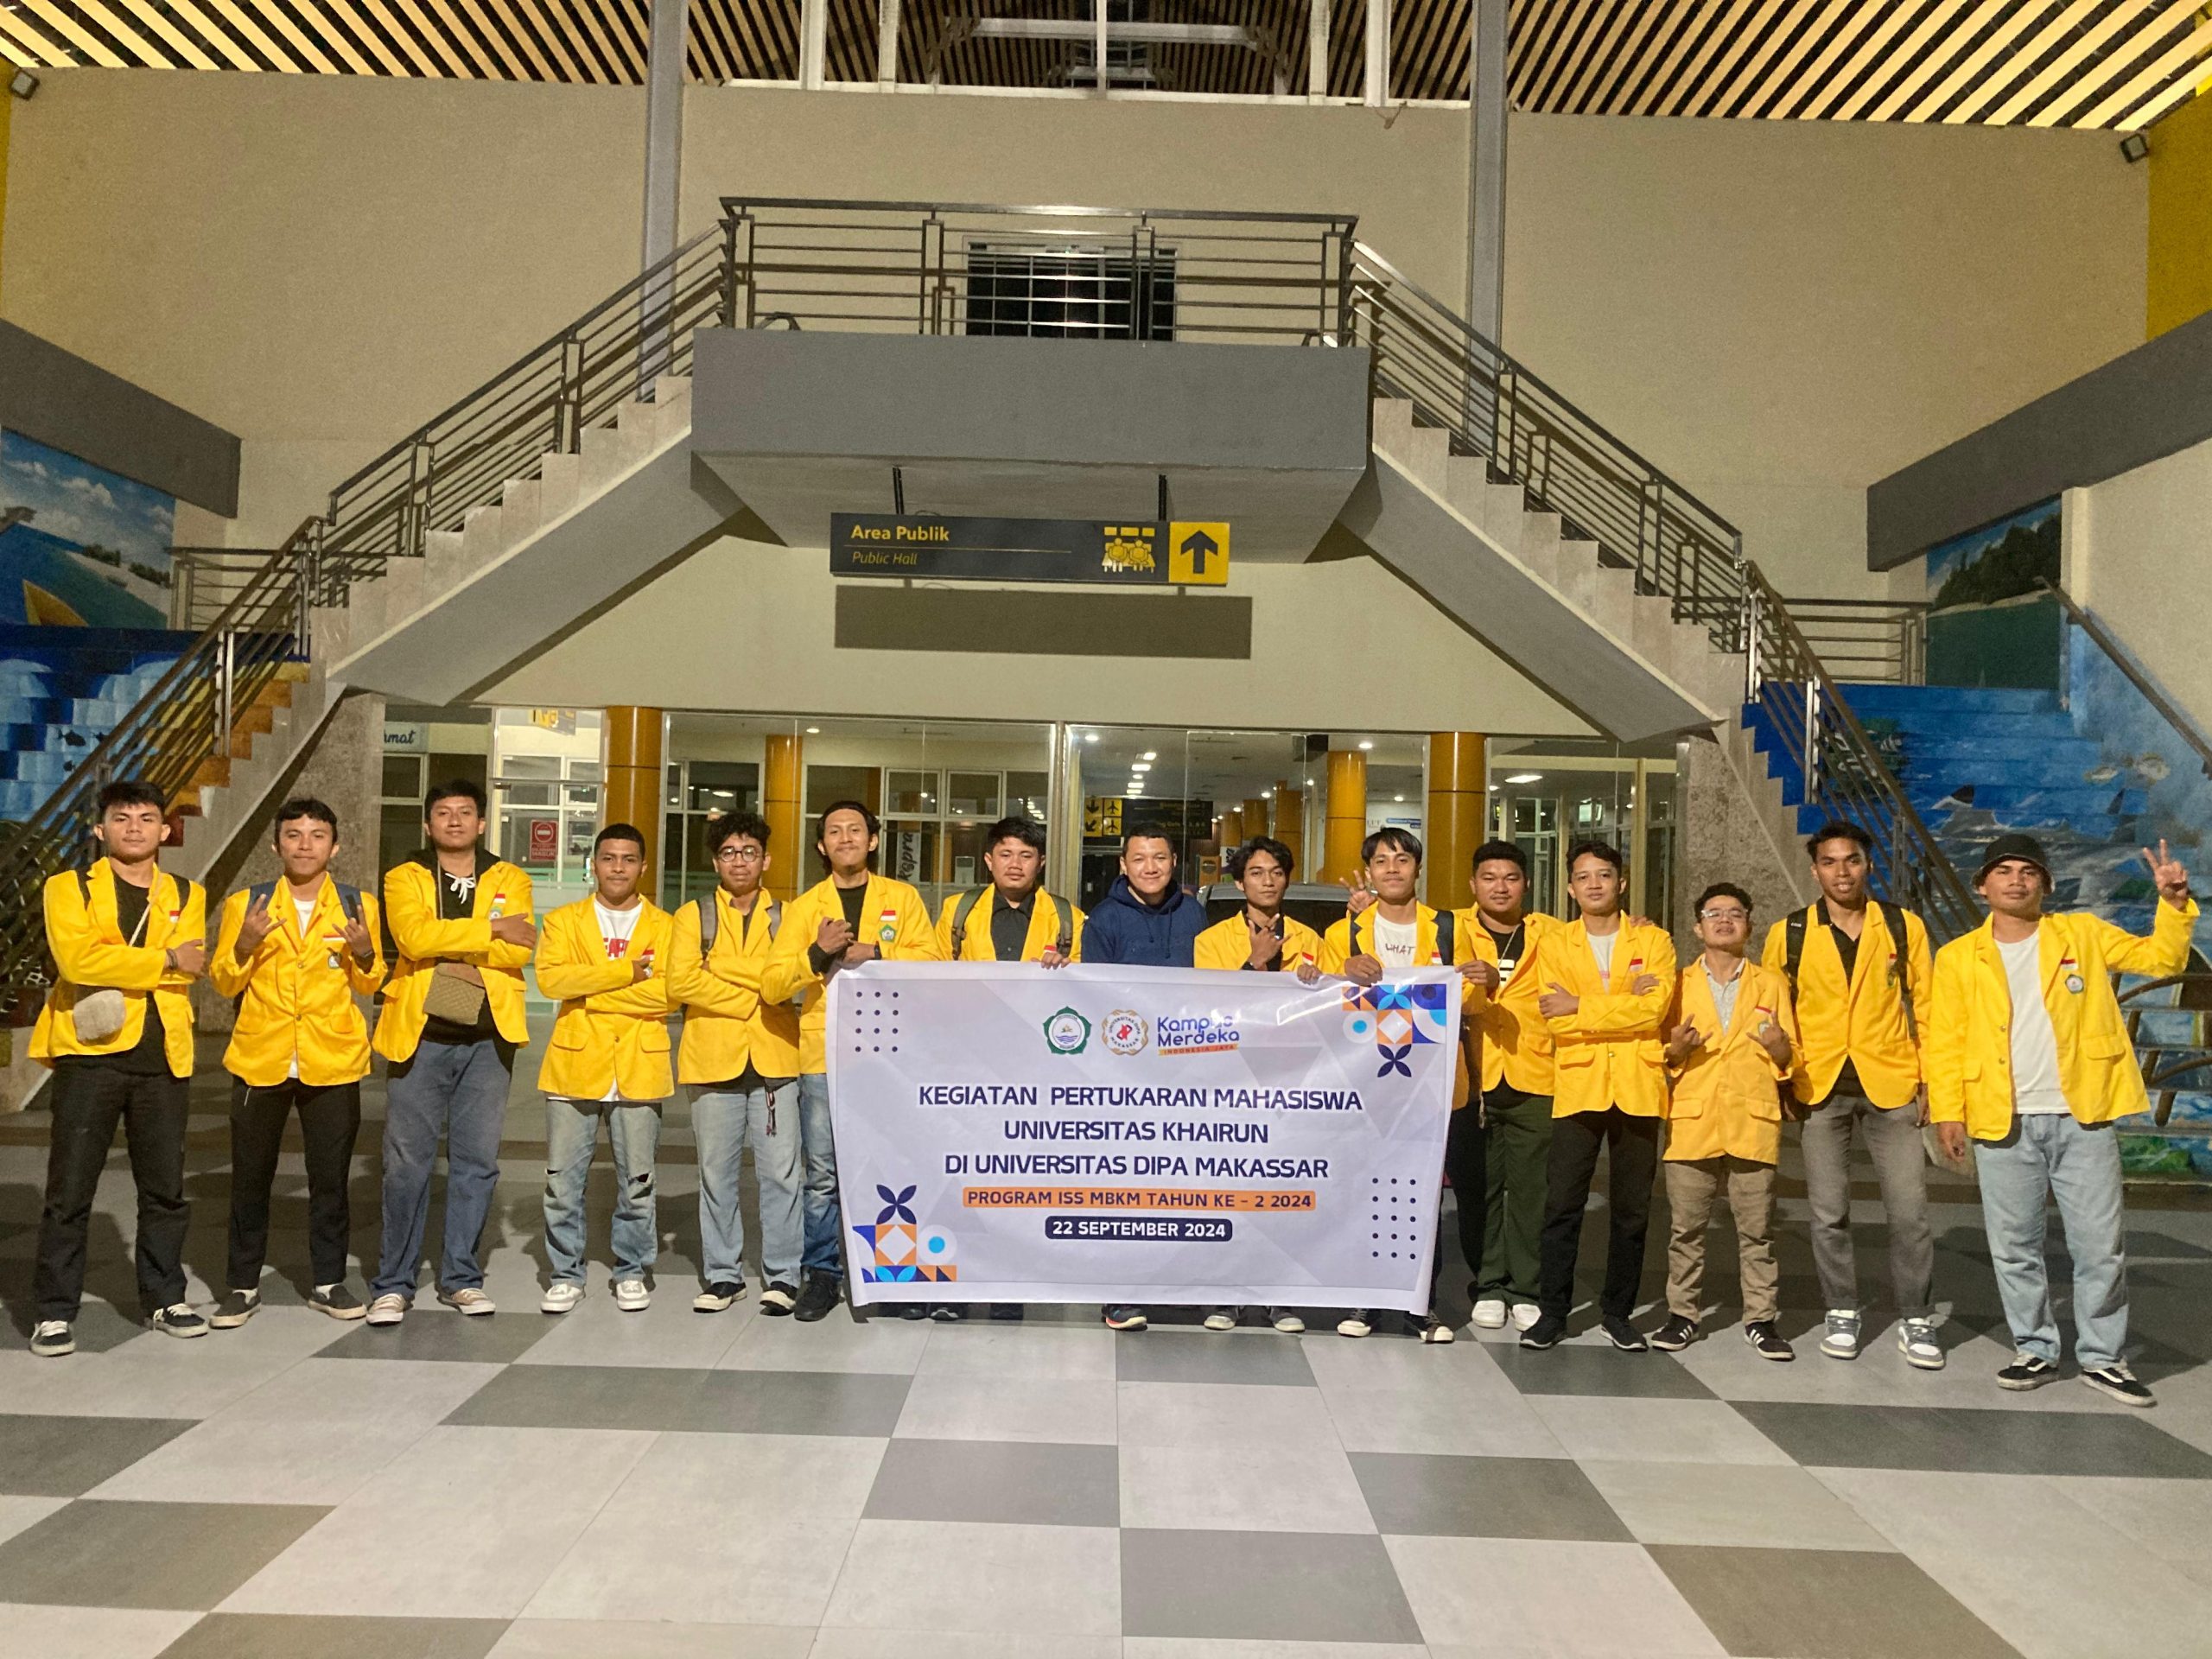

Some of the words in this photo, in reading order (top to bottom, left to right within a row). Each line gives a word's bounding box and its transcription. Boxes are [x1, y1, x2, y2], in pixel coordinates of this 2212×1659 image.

[850, 524, 891, 540] Area
[896, 525, 950, 541] Publik
[852, 551, 890, 564] Public
[893, 552, 918, 565] Hall
[1157, 1015, 1234, 1033] Kamps
[1157, 1029, 1240, 1047] Merdeka
[918, 1086, 1038, 1106] KEGIATAN
[1051, 1087, 1207, 1108] PERTUKARAN
[1214, 1089, 1363, 1110] MAHASISWA
[1004, 1121, 1156, 1141] UNIVERSITAS
[1162, 1122, 1268, 1143] KHAIRUN
[944, 1154, 968, 1174] DI
[975, 1154, 1128, 1175] UNIVERSITAS
[1134, 1156, 1189, 1176] DIPA
[1195, 1157, 1329, 1179] MAKASSAR
[968, 1191, 1052, 1205] PROGRAM
[1058, 1192, 1084, 1205] ISS
[1090, 1192, 1141, 1205] MBKM
[1147, 1192, 1208, 1206] TAHUN
[1214, 1194, 1236, 1207] KE
[1255, 1195, 1265, 1208] 2
[1271, 1195, 1313, 1208] 2024
[1052, 1221, 1073, 1235] 22
[1078, 1221, 1179, 1236] SEPTEMBER
[1185, 1223, 1225, 1237] 2024
